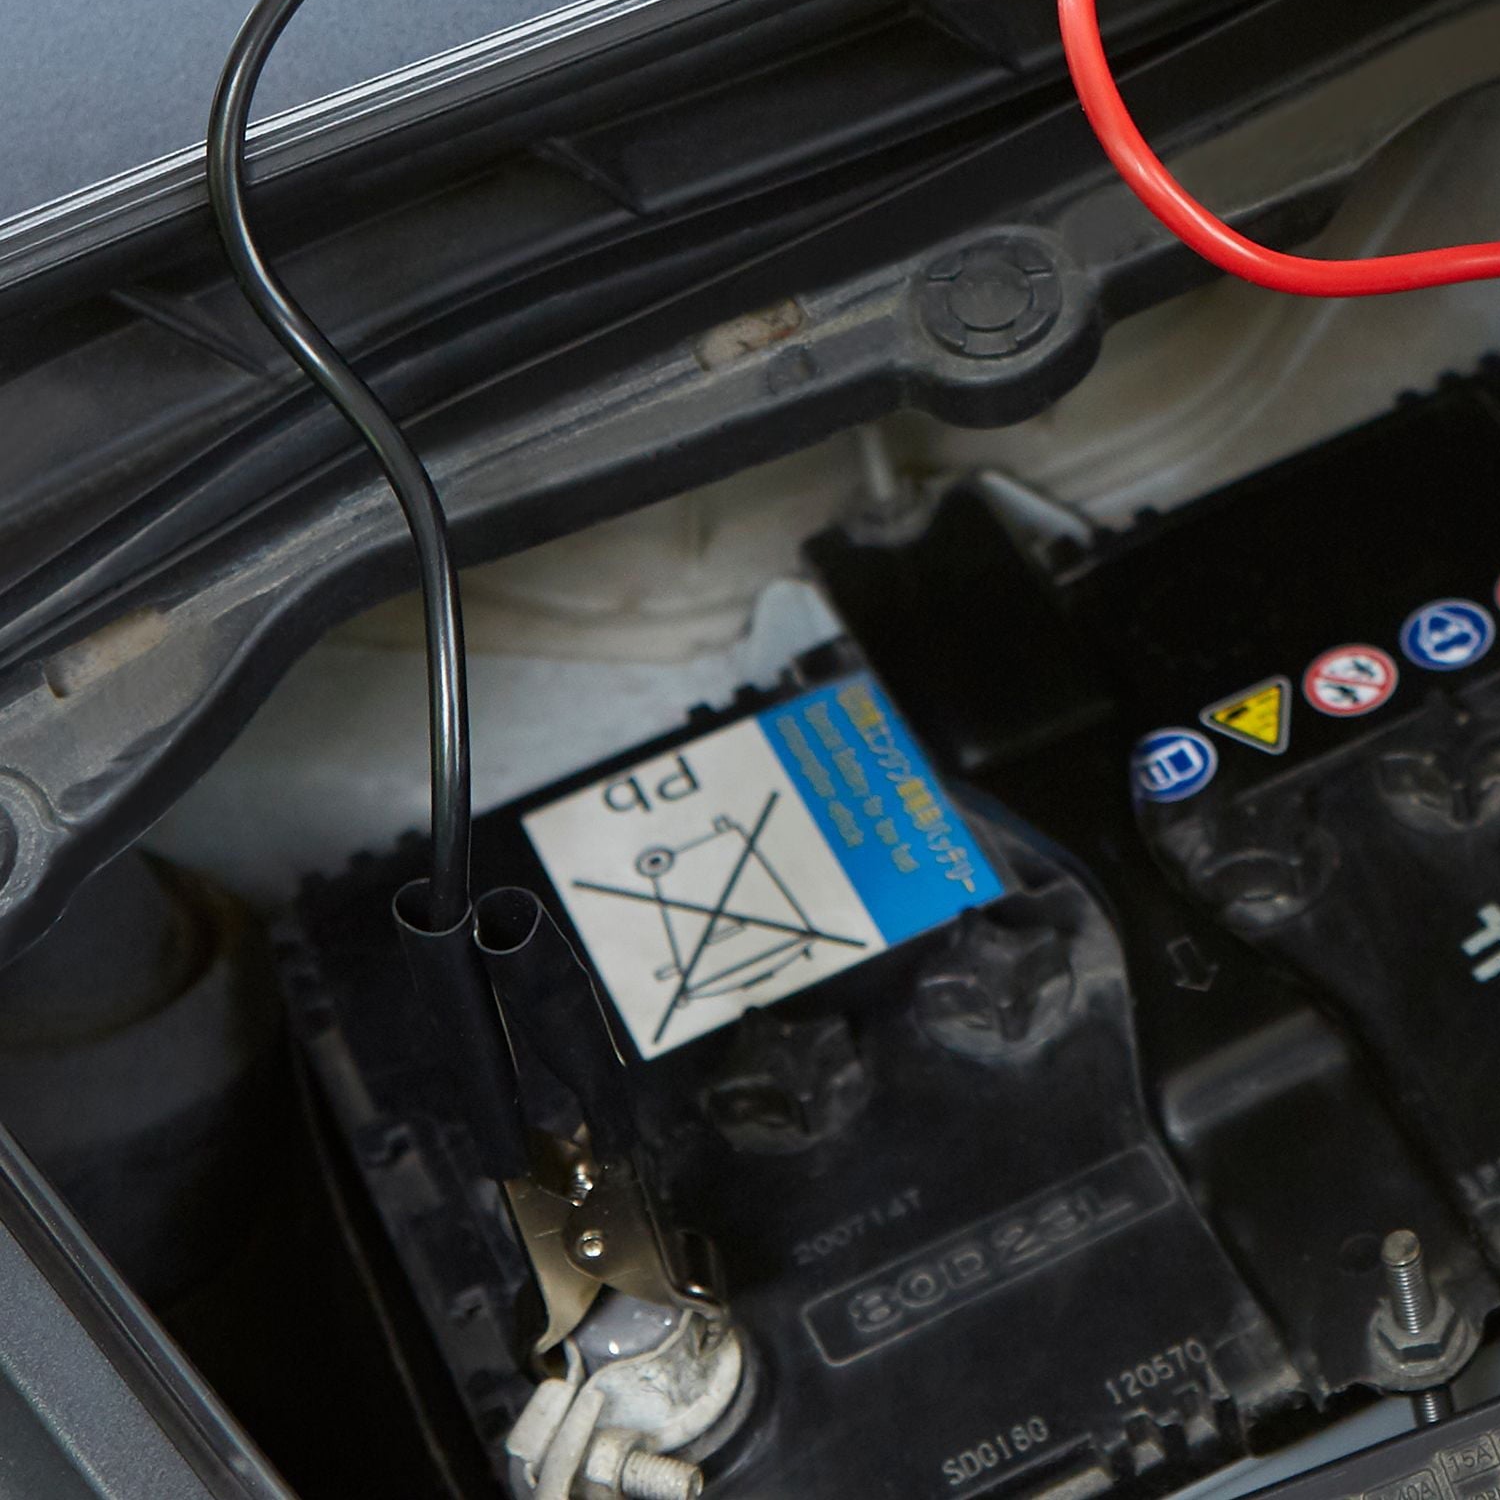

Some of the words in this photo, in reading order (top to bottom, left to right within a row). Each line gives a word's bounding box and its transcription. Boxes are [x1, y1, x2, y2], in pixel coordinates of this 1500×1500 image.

[602, 754, 700, 814] Pb
[1105, 1337, 1208, 1405] 120570
[1448, 1447, 1494, 1474] 15A
